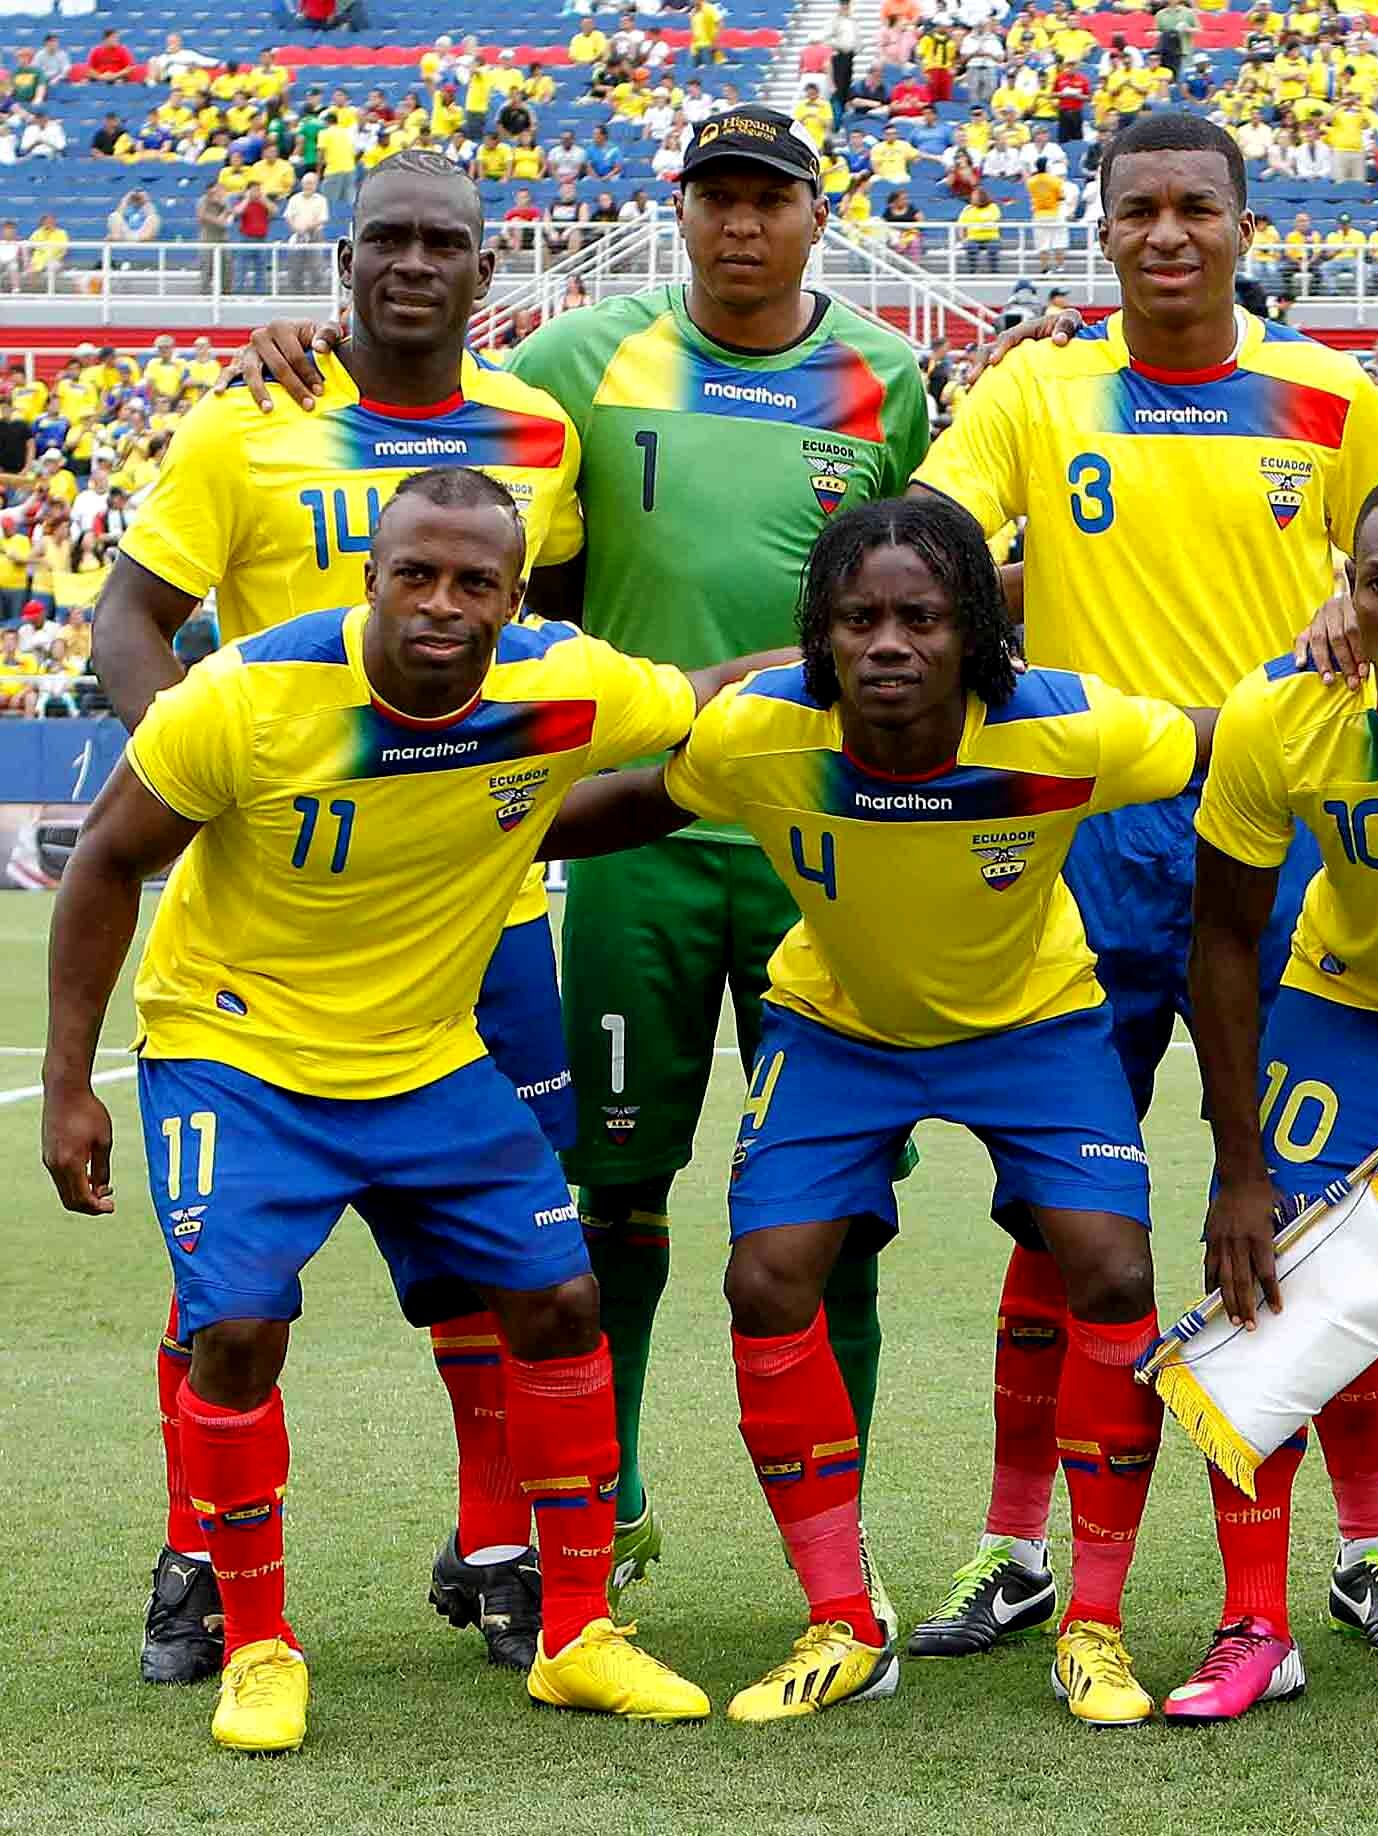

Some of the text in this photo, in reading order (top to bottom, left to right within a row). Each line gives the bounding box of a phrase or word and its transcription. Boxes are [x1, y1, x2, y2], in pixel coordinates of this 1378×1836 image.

[722, 117, 777, 136] Hispana
[704, 382, 797, 409] marathon
[1135, 407, 1228, 424] marathon
[375, 438, 467, 456] marathon
[802, 440, 855, 459] ECUADOR
[635, 431, 658, 512] 1
[1260, 457, 1313, 473] ECUADOR
[1068, 453, 1114, 534] 3
[300, 487, 380, 570] 14
[382, 740, 478, 762] marathon
[489, 768, 549, 788] ECUADOR
[856, 793, 952, 810] marathon
[292, 796, 355, 873] 11
[972, 831, 1036, 844] ECUADOR
[790, 826, 836, 900] 4
[601, 1014, 625, 1093] 1
[744, 1050, 785, 1129] 4
[1259, 1061, 1339, 1163] 10
[162, 1112, 216, 1200] 11
